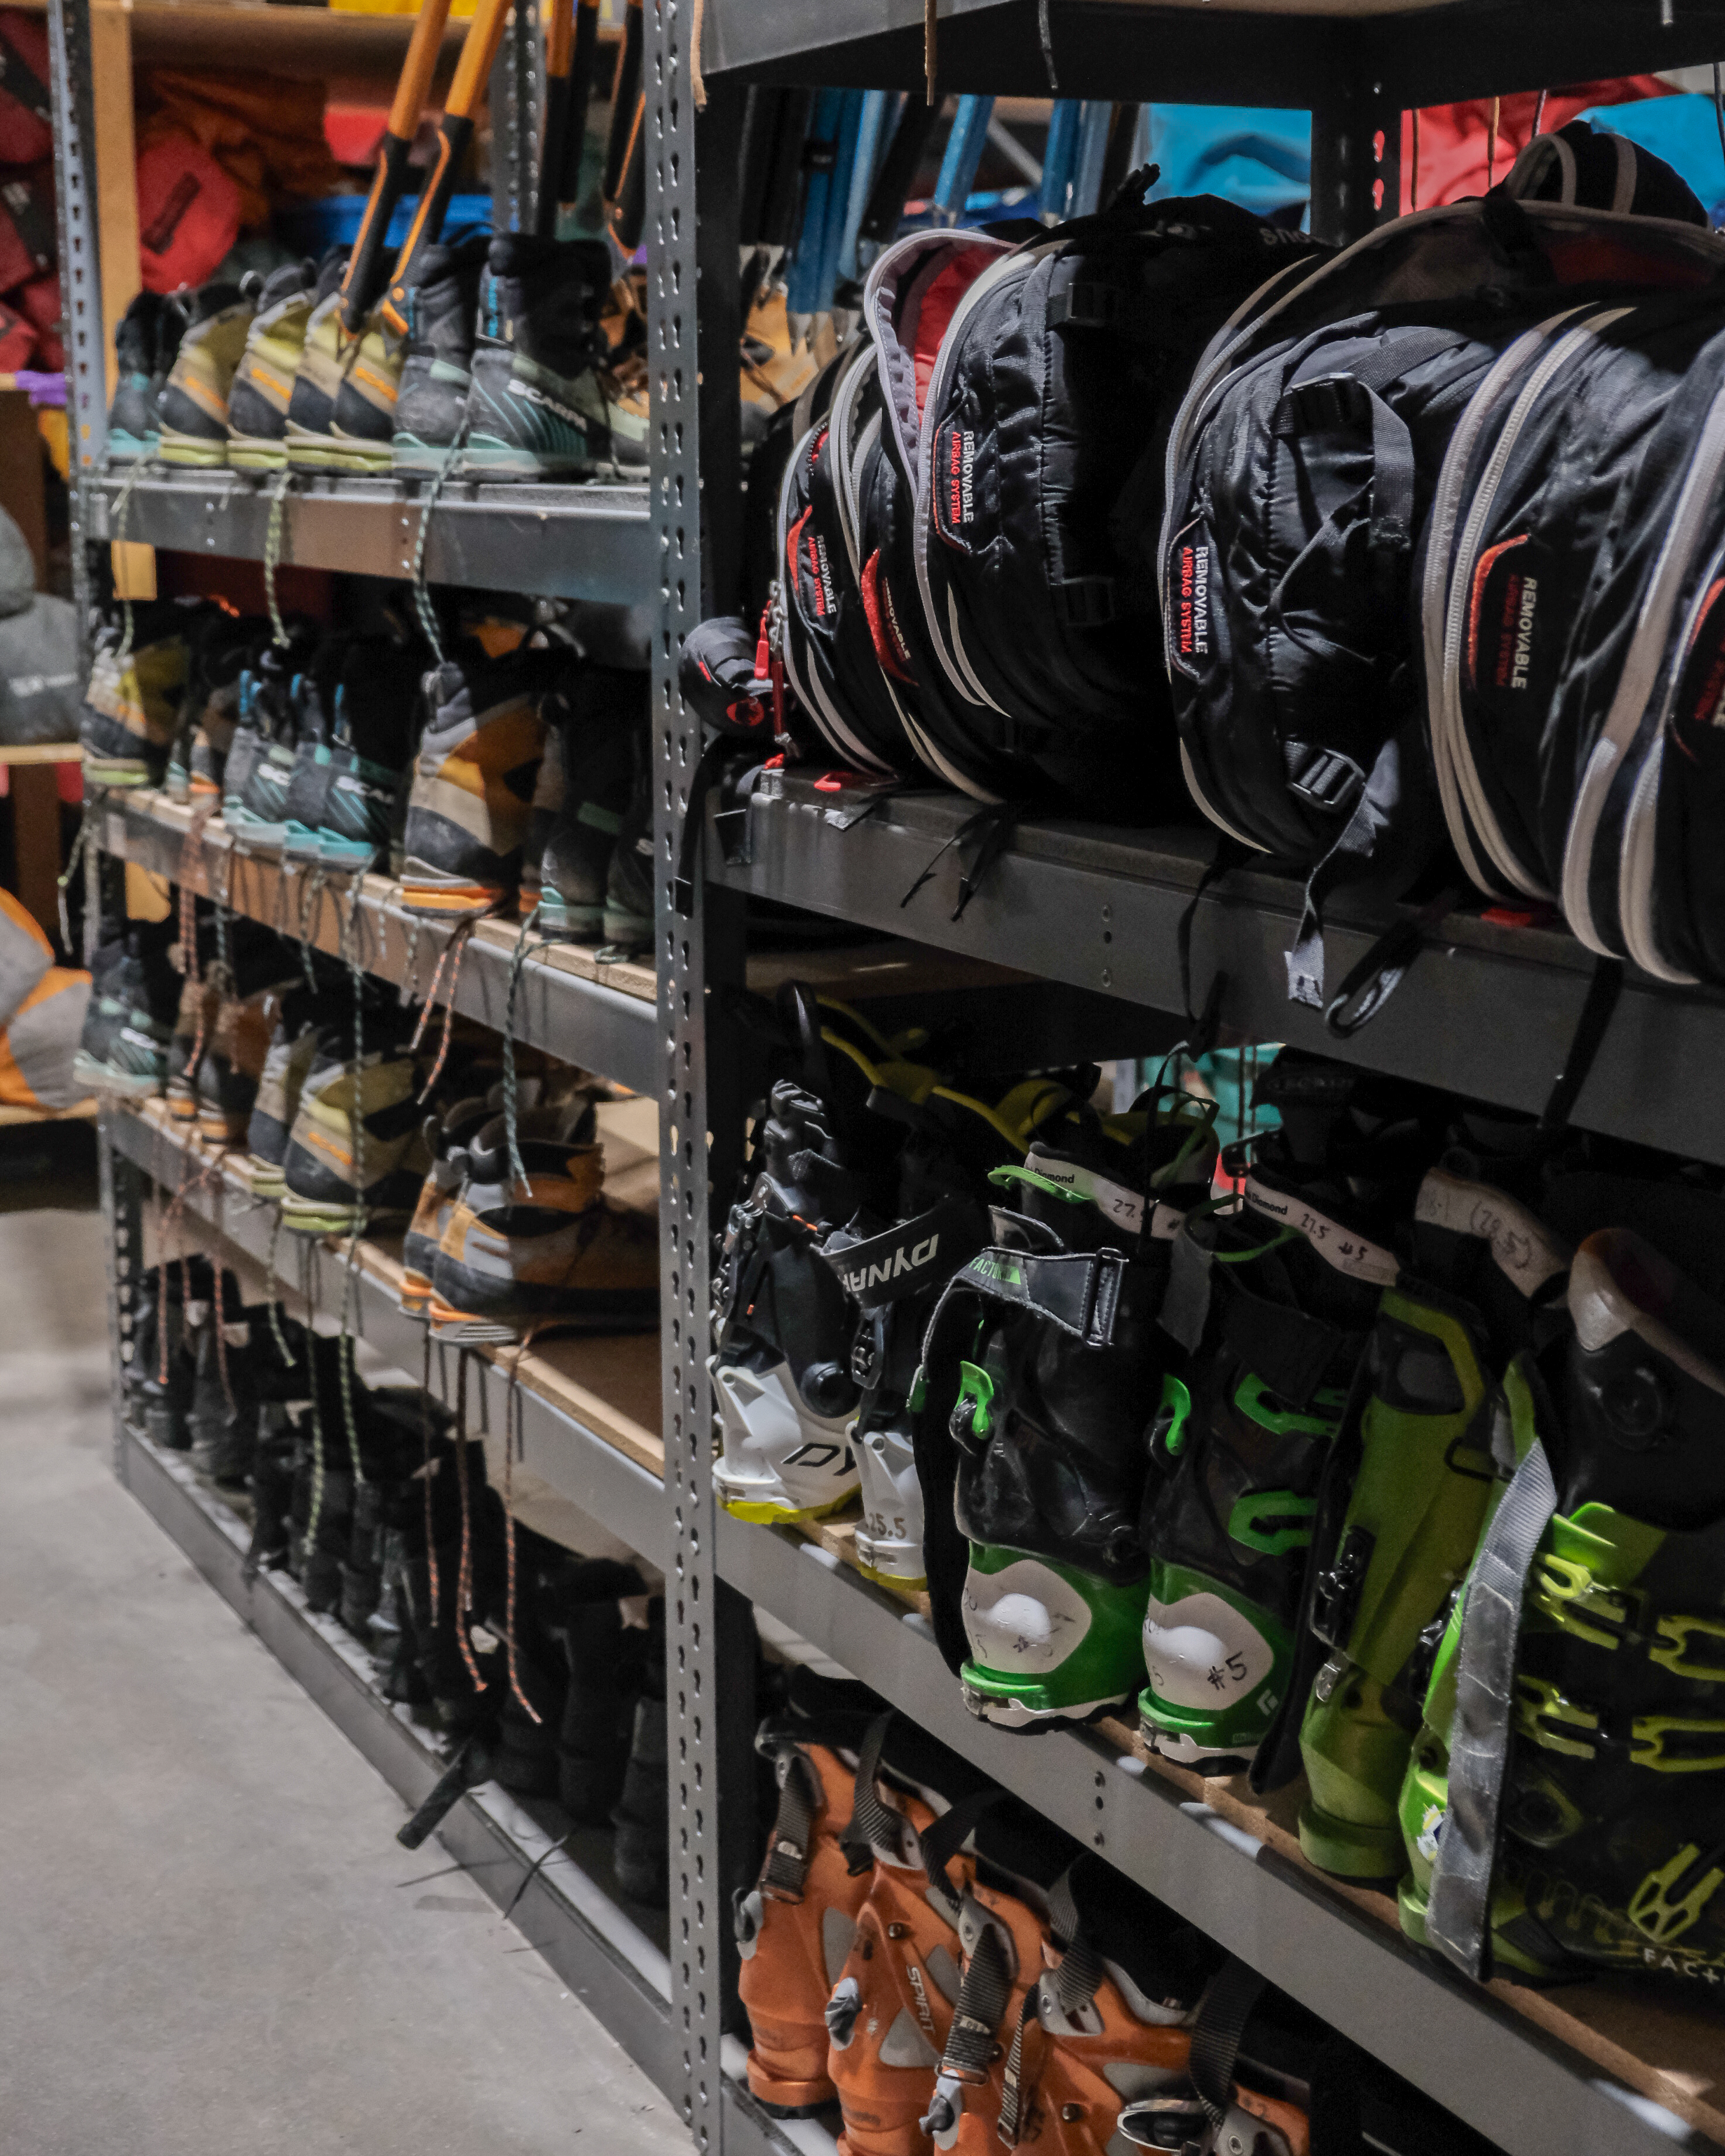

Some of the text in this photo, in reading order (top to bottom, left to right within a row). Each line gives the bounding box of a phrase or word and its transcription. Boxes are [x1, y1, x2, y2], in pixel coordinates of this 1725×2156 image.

[950, 431, 962, 524] AIRBAG SYSTEM
[962, 430, 975, 524] REMOVABLE
[807, 537, 826, 616] AIRBAG SYSTEM
[817, 534, 837, 614] REMOVABLE
[1179, 547, 1194, 653] AIRBAG SYSTEM
[1194, 546, 1209, 654] REMOVABLE
[1510, 576, 1538, 690] REMOVABLE
[1113, 1199, 1144, 1222] 27.
[1300, 1213, 1328, 1239] 27.5
[1207, 1651, 1247, 1690] #5
[906, 1965, 936, 2035] SPIRIT
